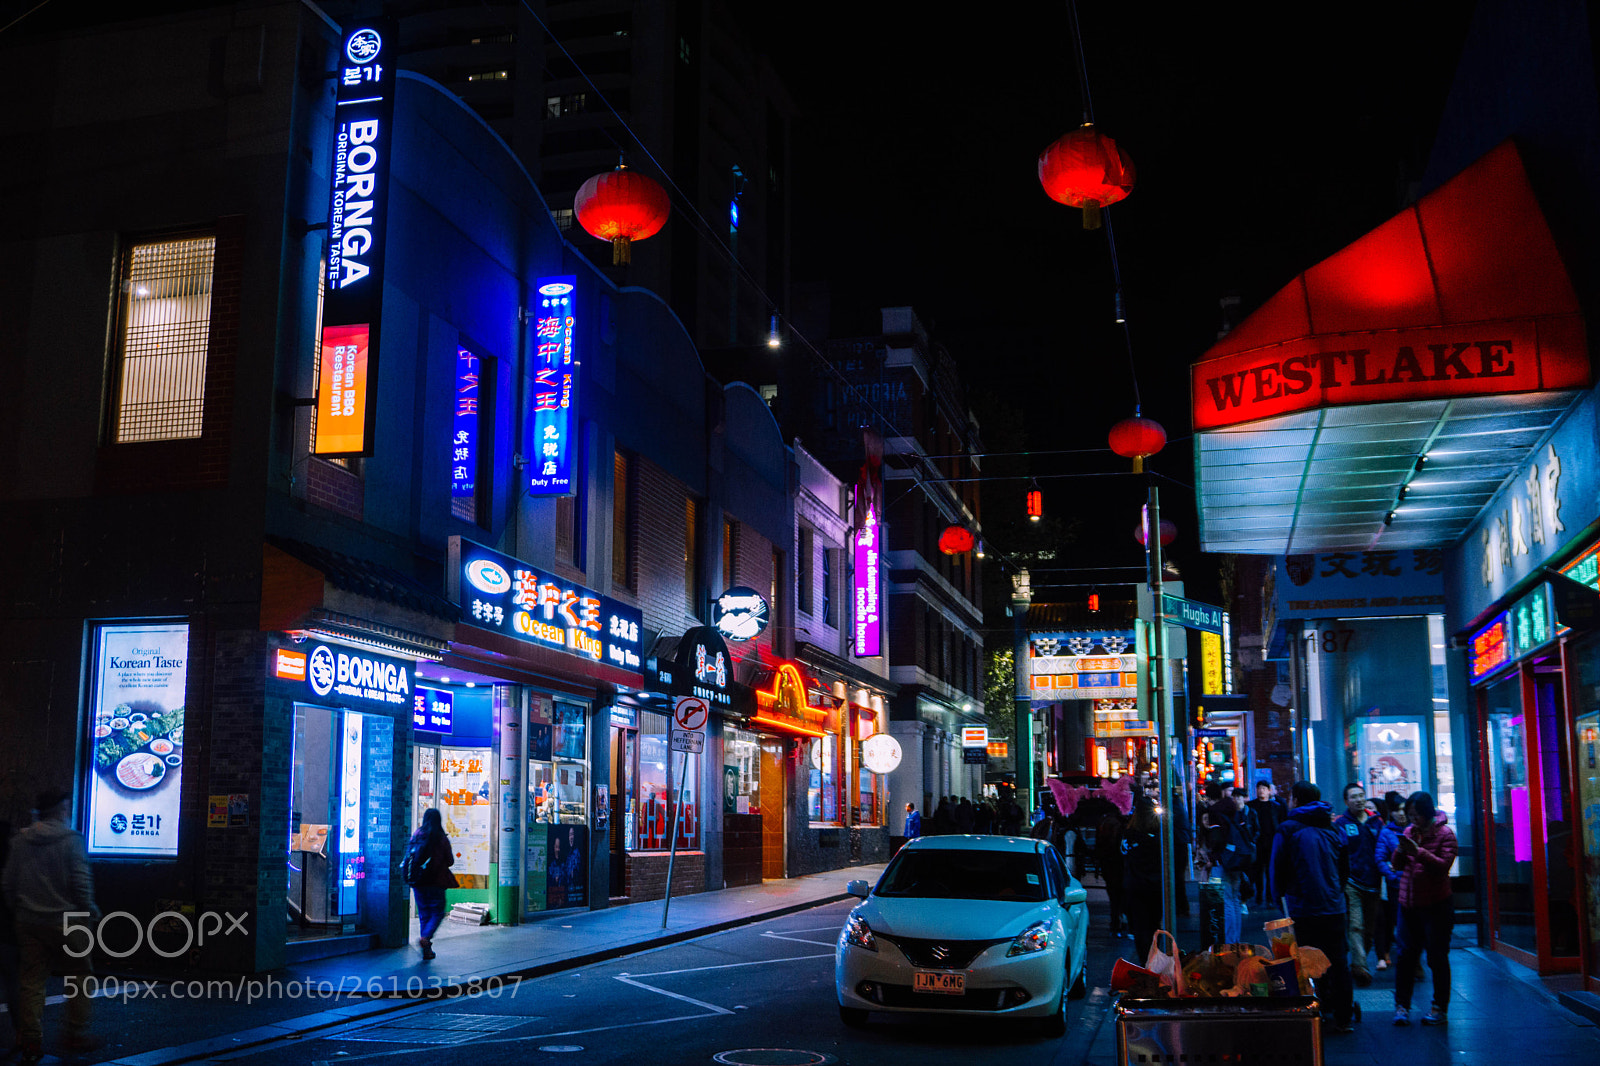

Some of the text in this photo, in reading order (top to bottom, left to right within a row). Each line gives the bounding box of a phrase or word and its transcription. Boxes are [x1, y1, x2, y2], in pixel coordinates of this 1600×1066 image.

[344, 64, 382, 86] 본가
[332, 191, 344, 238] KOREAN
[340, 119, 379, 288] BORNGA
[331, 345, 346, 416] Restaurant
[343, 345, 358, 416] Korean BBQ
[534, 316, 562, 412] 海中之王
[560, 316, 574, 408] Ocean King
[1206, 340, 1515, 412] WESTLAKE
[542, 424, 559, 475] 免税店
[531, 477, 568, 487] Duty Free
[866, 566, 878, 613] dumpling
[515, 611, 602, 660] Ocean King
[856, 587, 868, 654] noodle house
[867, 614, 878, 624] &
[1183, 602, 1221, 627] Hughs Al
[110, 655, 182, 668] Korean Taste
[131, 646, 160, 656] Original
[1306, 629, 1354, 653] 187
[337, 653, 409, 694] BORNGA
[131, 814, 162, 830] 본가
[943, 976, 963, 988] 6MG
